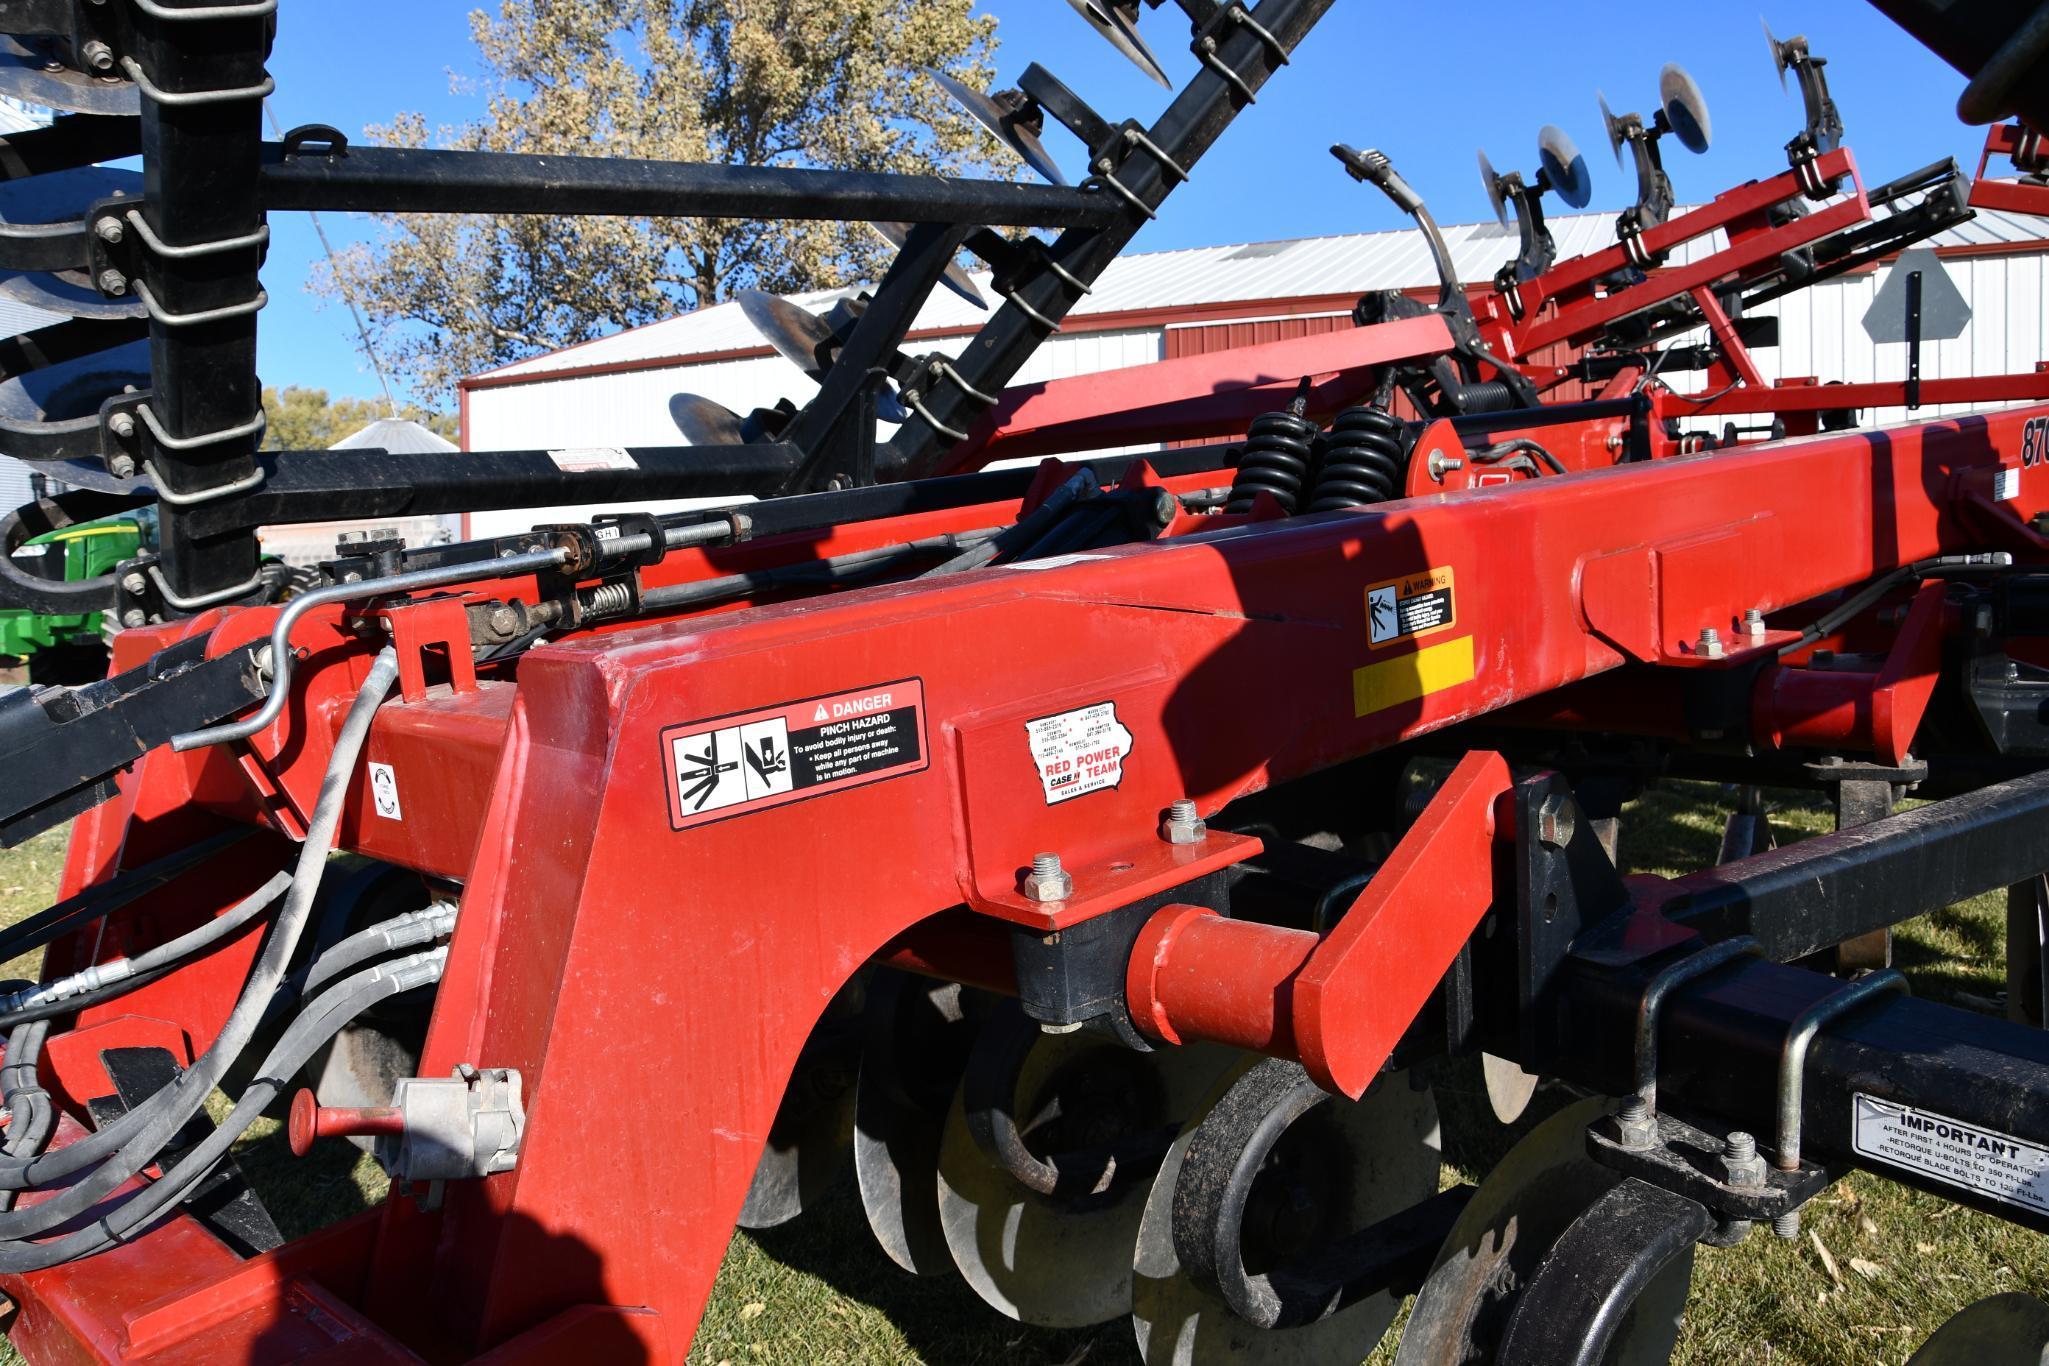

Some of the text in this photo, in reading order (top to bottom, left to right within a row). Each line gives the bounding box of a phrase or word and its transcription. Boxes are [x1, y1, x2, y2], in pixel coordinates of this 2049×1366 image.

[1414, 575, 1446, 590] WARNING
[833, 694, 892, 717] DANGER
[820, 714, 890, 737] PINCH HAZARD
[794, 746, 803, 754] To
[805, 741, 824, 752] avoid
[825, 737, 846, 746] bodily
[847, 733, 866, 743] injury
[876, 725, 896, 736] death:
[814, 740, 888, 762] Keep all persons away
[815, 746, 899, 771] while any part of machine
[1045, 760, 1071, 777] RED
[1077, 746, 1120, 768] POWER
[1086, 761, 1117, 778] TEAM
[816, 767, 858, 782] is in motion.
[1050, 774, 1072, 787] CASE
[1061, 787, 1077, 796] SALES
[1084, 778, 1105, 789] SERVICE
[1901, 1113, 2019, 1159] IMPORTANT
[1883, 1124, 1908, 1137] AFTER
[1911, 1132, 1933, 1144] FIRST
[1943, 1143, 1972, 1157] HOURS
[1975, 1152, 1986, 1160] OF
[1989, 1157, 2040, 1178] OPERATION
[1935, 1151, 1970, 1168] U-BOLTS
[1973, 1162, 1985, 1172] TO
[1924, 1158, 1951, 1172] BLADE
[1953, 1168, 1980, 1181] BOLTS
[1984, 1177, 1996, 1187] TO
